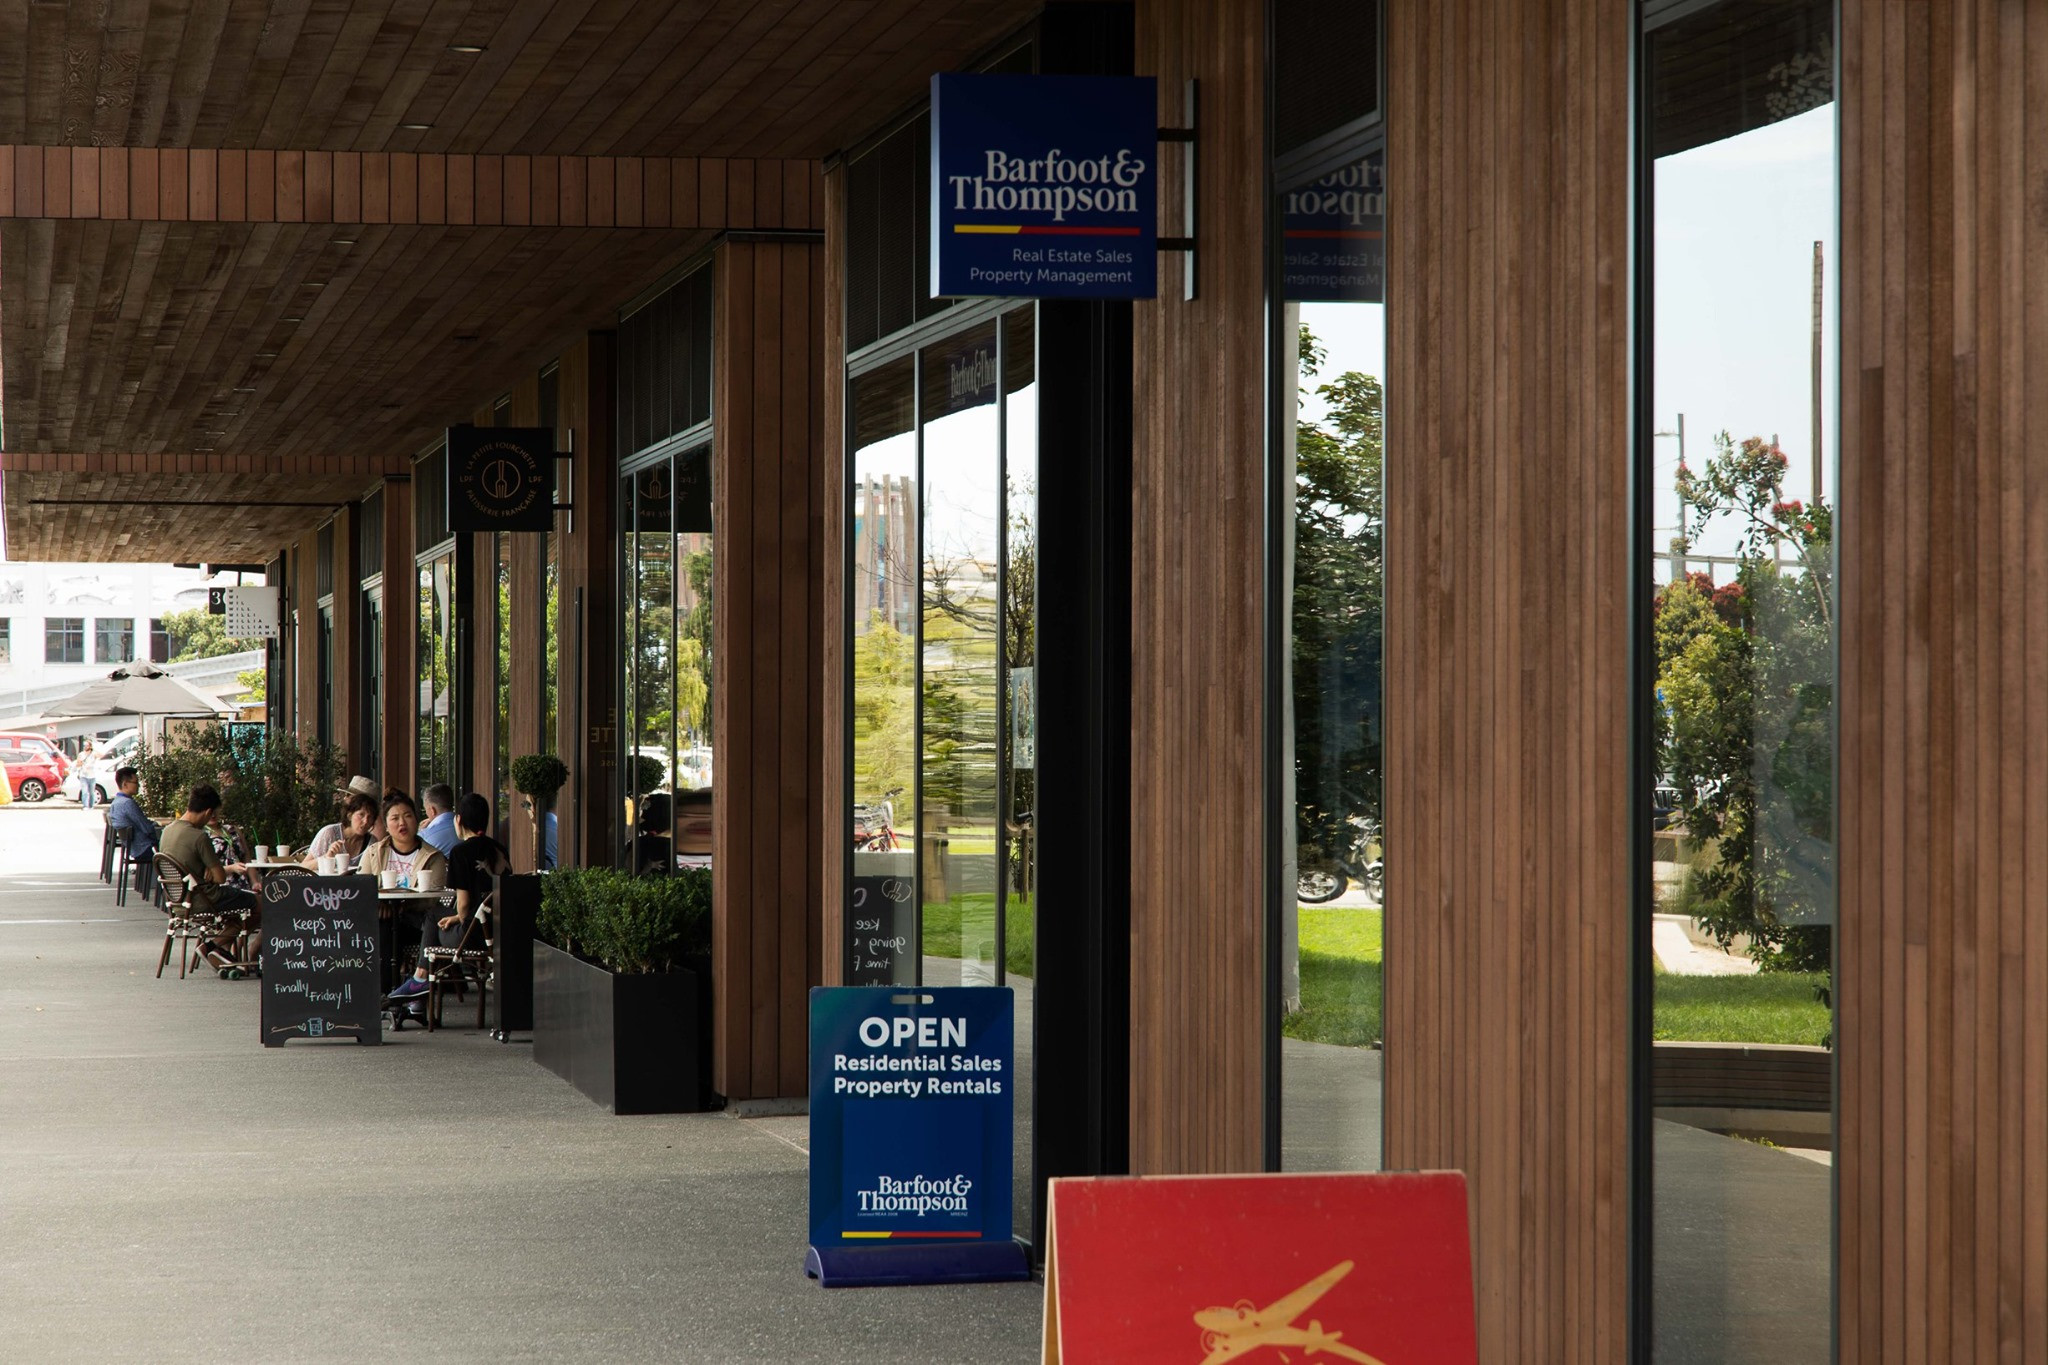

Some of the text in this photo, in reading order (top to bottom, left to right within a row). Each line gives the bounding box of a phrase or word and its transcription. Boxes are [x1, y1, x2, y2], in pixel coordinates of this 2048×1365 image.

[949, 176, 1138, 221] Thompson
[1013, 248, 1132, 264] Real Estate Sales
[970, 268, 1132, 285] Property Management
[303, 887, 359, 911] Coffee
[333, 918, 354, 930] me
[270, 932, 374, 956] going until it is
[283, 956, 364, 972] time for wine
[859, 1016, 966, 1048] OPEN
[834, 1054, 1002, 1072] Residential Sales
[834, 1078, 1002, 1098] Property Rentals
[858, 1190, 968, 1216] Thompson
